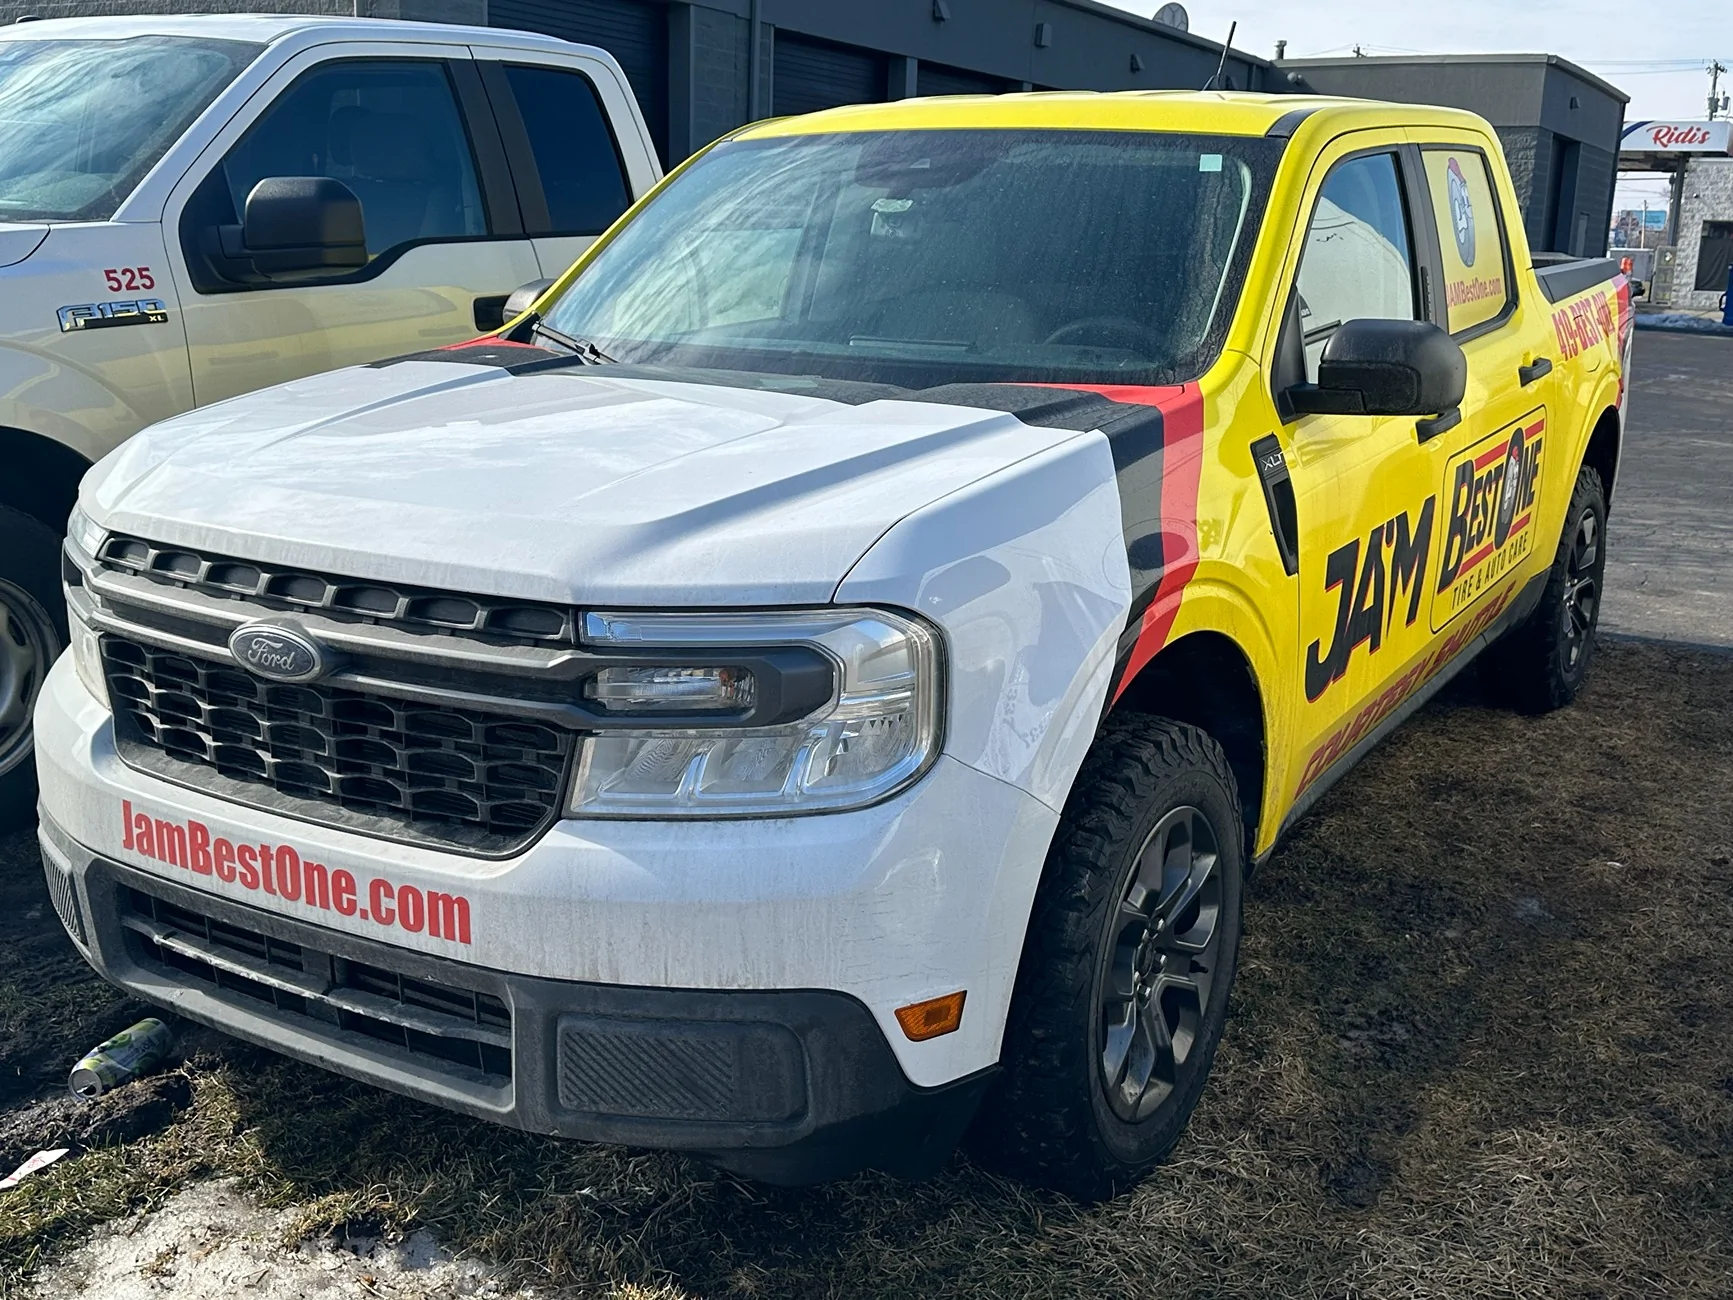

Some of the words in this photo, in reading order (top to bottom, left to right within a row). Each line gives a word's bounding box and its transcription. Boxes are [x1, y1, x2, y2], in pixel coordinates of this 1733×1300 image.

[104, 267, 155, 291] 525
[1261, 451, 1283, 470] XLT
[1452, 574, 1474, 610] TIRE
[1484, 549, 1507, 583] AUTO
[1508, 531, 1528, 565] CARE
[247, 637, 295, 672] Ford
[122, 799, 472, 945] JamBestOne.com
